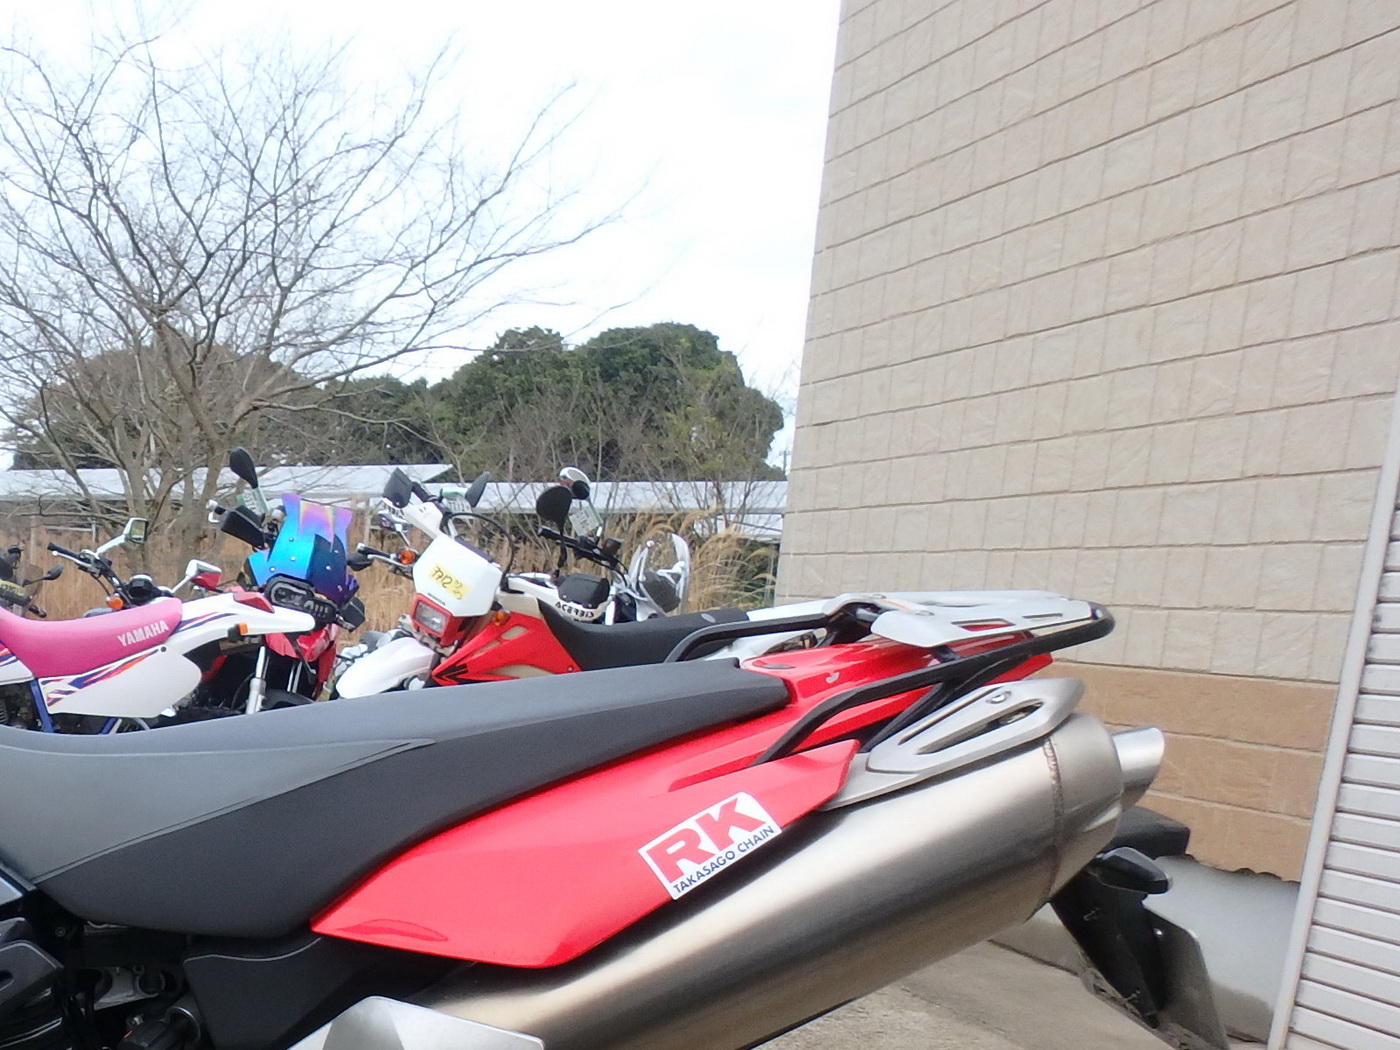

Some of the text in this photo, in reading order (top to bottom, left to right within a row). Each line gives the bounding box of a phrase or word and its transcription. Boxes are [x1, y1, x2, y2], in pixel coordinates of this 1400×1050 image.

[117, 620, 169, 646] YAMAHA
[649, 797, 767, 884] RK
[672, 825, 775, 894] TAKASAGO CHAIN
